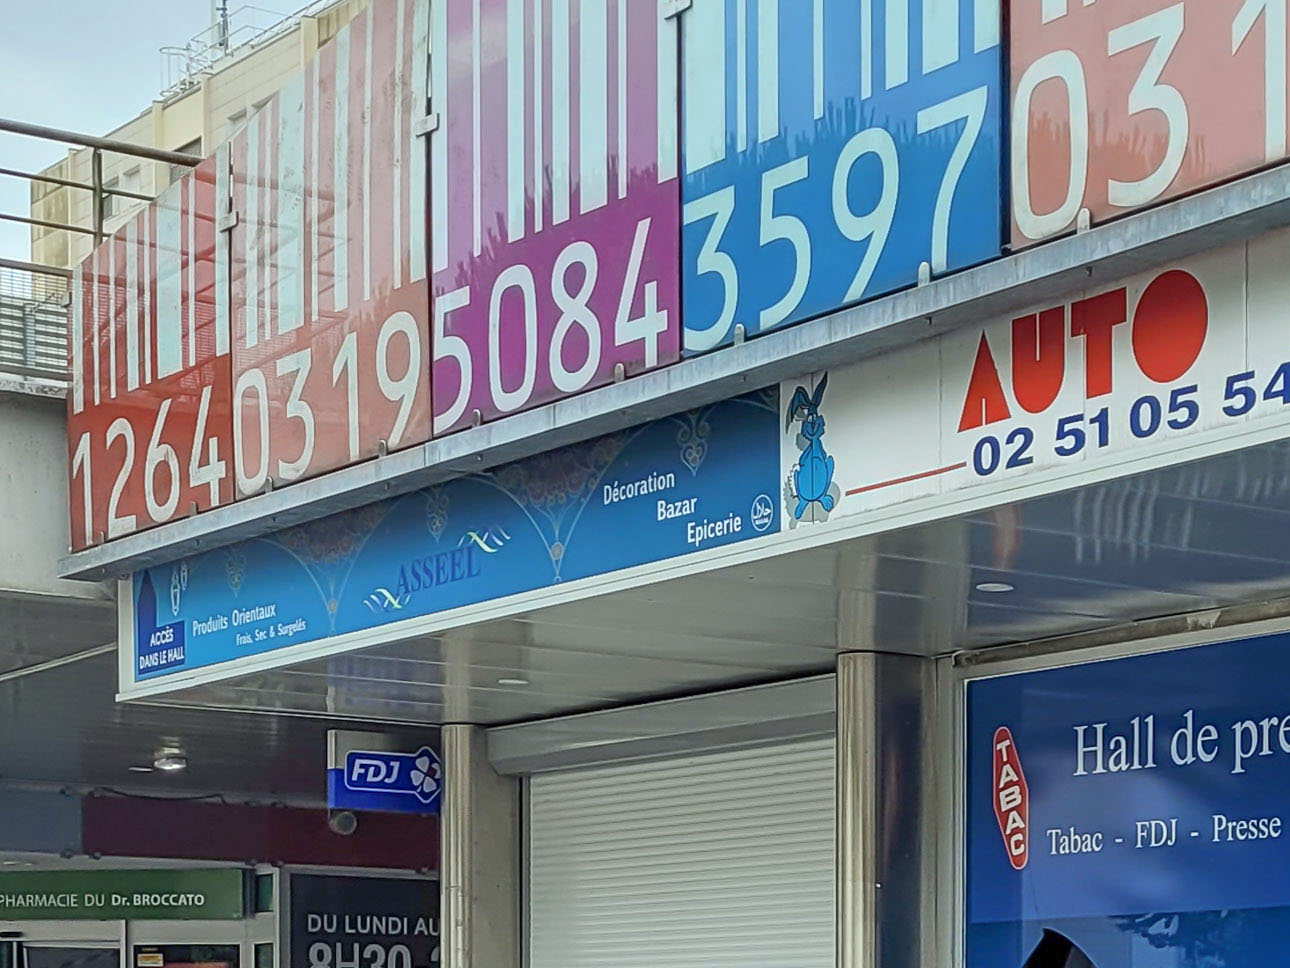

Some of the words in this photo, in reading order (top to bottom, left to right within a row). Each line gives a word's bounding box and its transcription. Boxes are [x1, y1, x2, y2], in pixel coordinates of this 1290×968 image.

[957, 269, 1209, 433] AUTO
[973, 428, 1034, 476] 02
[1055, 414, 1109, 457] 51
[1129, 384, 1200, 438] 05
[603, 472, 675, 505] Décoration
[657, 498, 698, 521] Bazar
[687, 513, 742, 546] Epicerie
[396, 546, 482, 597] ASSEEL
[150, 626, 174, 647] ACCÈS
[192, 615, 229, 636] Produits
[232, 604, 276, 626] Orientaux
[140, 652, 159, 669] DANS
[159, 650, 167, 665] LE
[168, 647, 185, 662] HALL
[1072, 715, 1156, 777] Hall
[1170, 711, 1218, 766] de
[351, 758, 399, 785] FDJ
[996, 739, 1025, 857] TABAC
[1047, 828, 1104, 856] Tabac
[1135, 818, 1178, 849] FDJ
[1212, 814, 1282, 844] Presse
[85, 894, 105, 907] DU
[112, 894, 130, 906] Dr.
[134, 894, 205, 906] BROCCATO
[307, 914, 337, 933] DU
[345, 915, 408, 935] LUNDI
